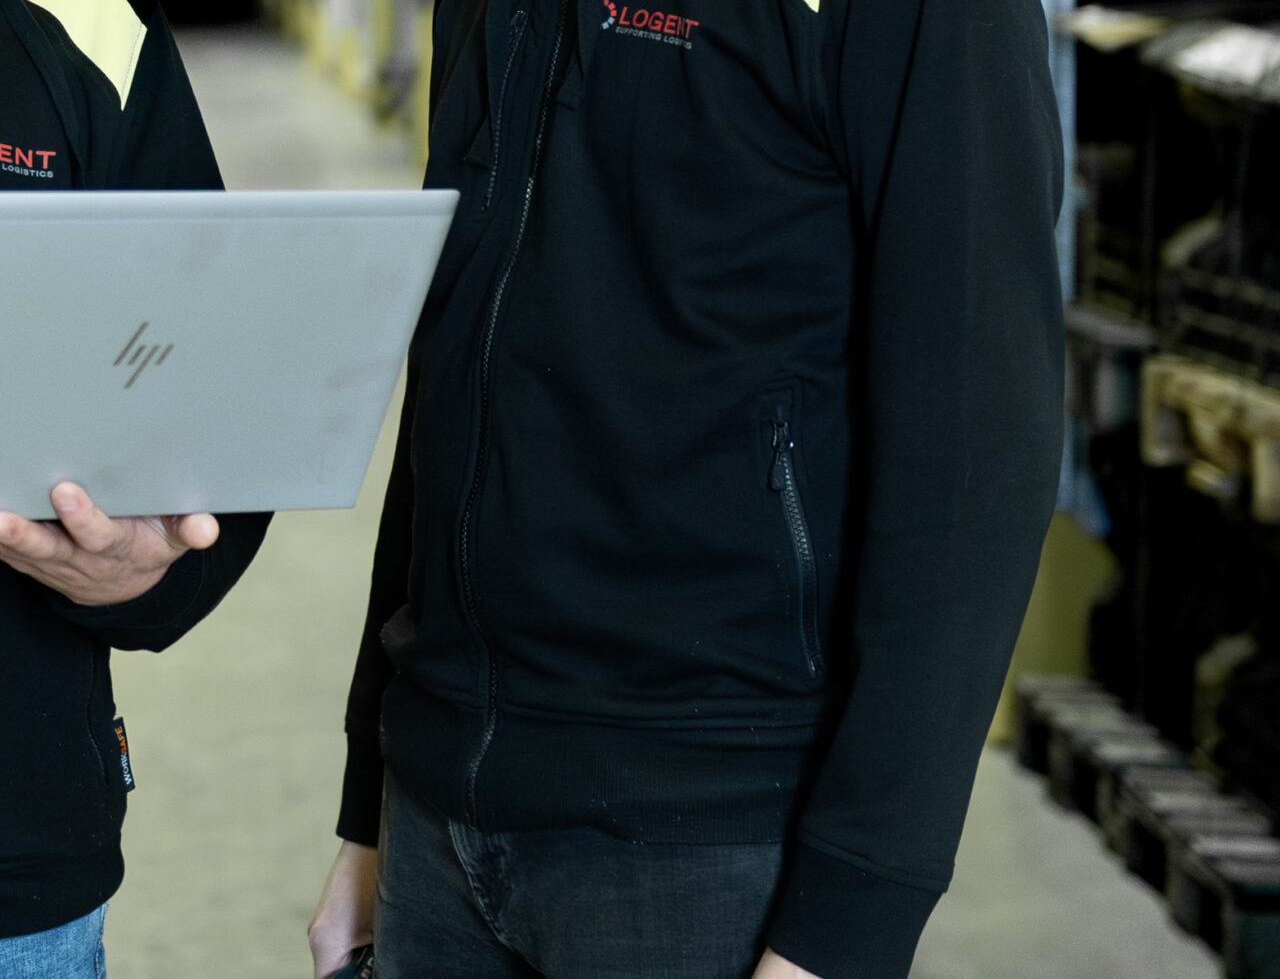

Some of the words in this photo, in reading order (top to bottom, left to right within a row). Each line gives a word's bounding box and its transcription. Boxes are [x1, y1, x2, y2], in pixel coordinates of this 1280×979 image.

[615, 26, 662, 41] SUPPORTING
[618, 6, 700, 39] LOGENT
[2, 163, 54, 178] LOGISTICS
[112, 321, 175, 390] hp
[114, 725, 132, 785] WORKSAFE
